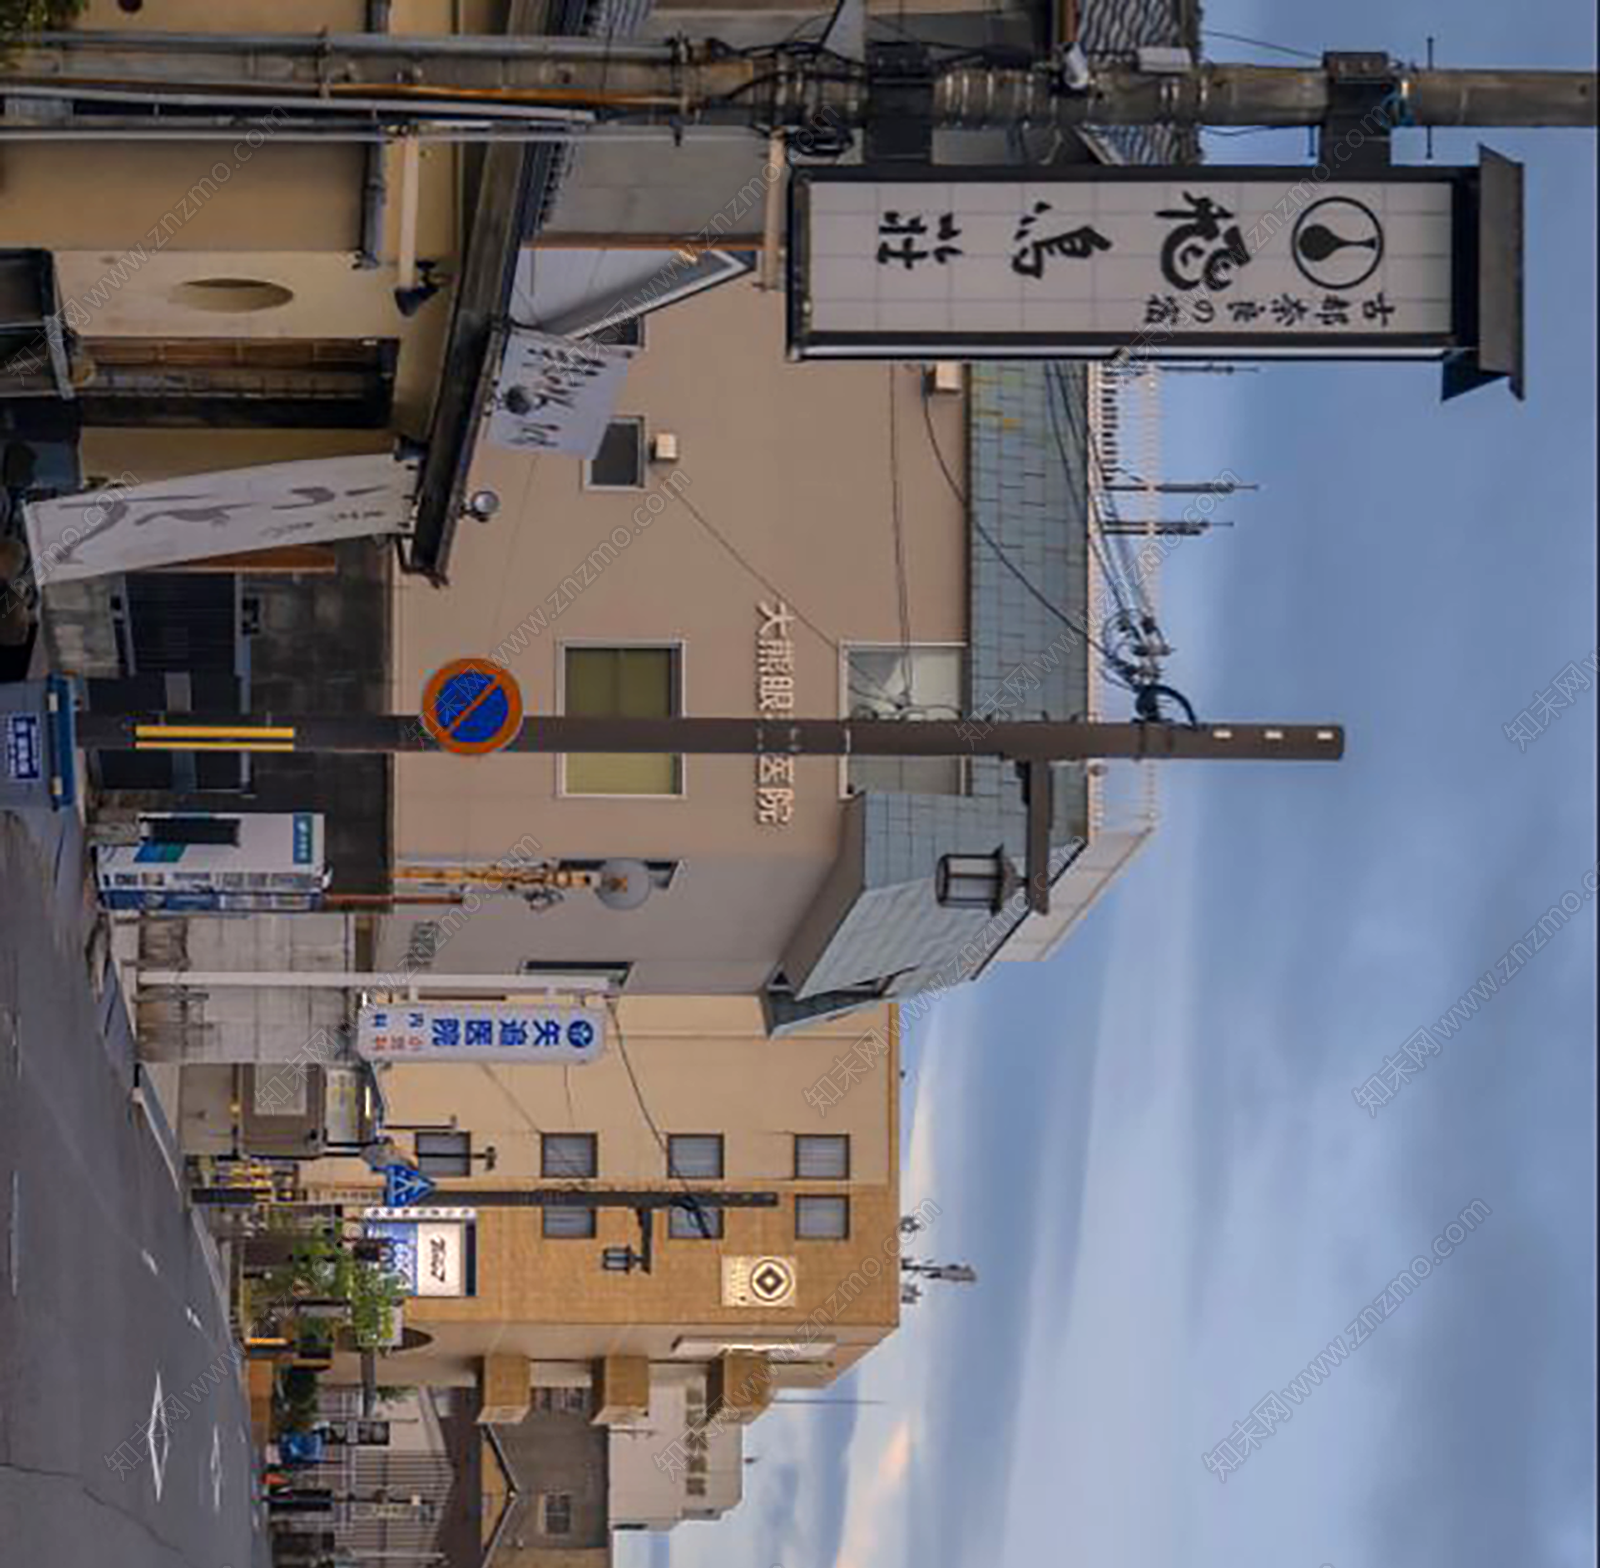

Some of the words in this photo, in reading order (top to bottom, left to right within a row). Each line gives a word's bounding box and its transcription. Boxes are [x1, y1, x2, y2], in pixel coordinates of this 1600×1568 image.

[1144, 293, 1396, 326] 古都奈良の宿
[756, 601, 795, 825] 大熊眼医院
[432, 1019, 560, 1047] 矢追医院
